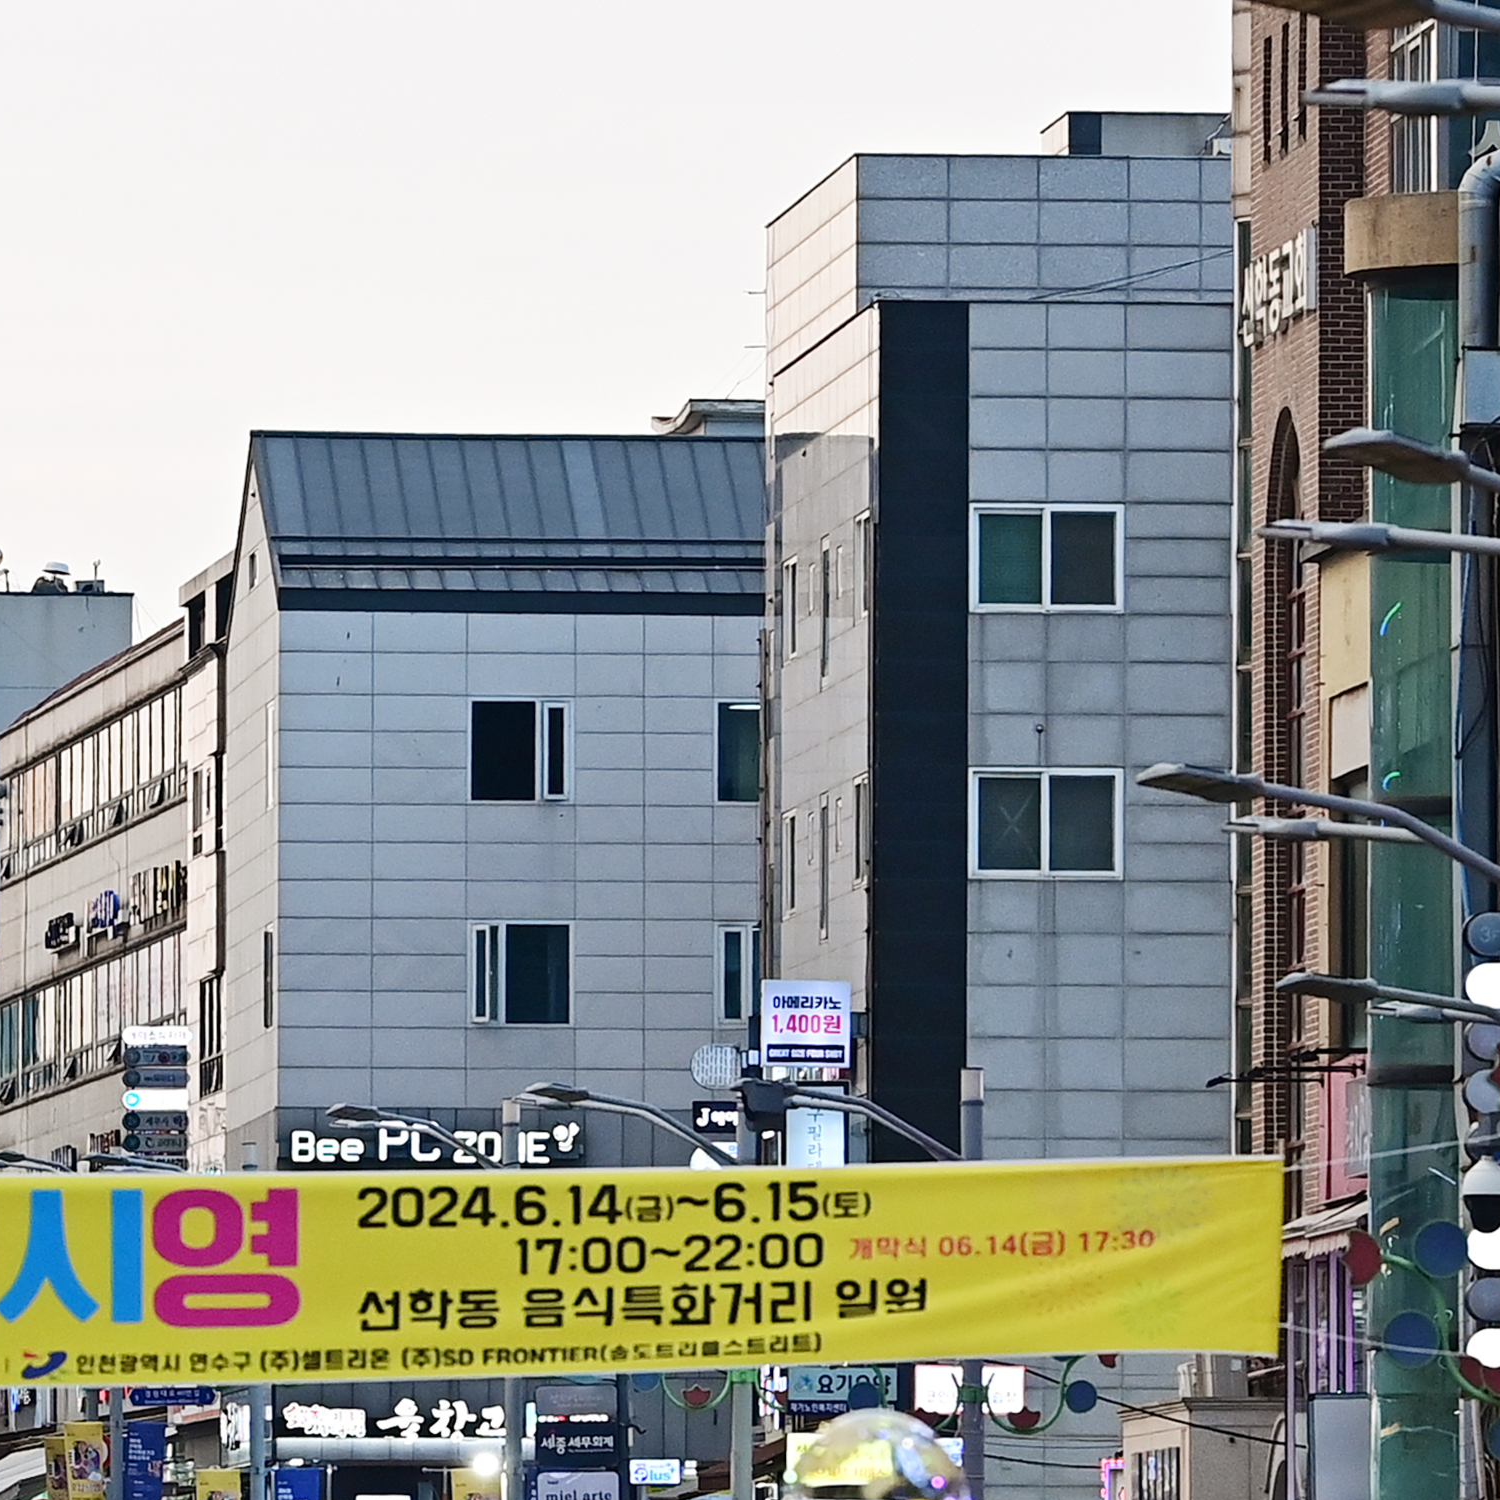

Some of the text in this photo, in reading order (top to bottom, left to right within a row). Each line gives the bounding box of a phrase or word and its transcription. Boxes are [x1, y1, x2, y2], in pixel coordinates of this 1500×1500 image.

[773, 995, 842, 1010] 아메리카노
[772, 1014, 842, 1034] 1,400원
[291, 1130, 365, 1163] Bee
[378, 1120, 441, 1162] PC
[517, 1233, 824, 1275] 17:00~22:00
[849, 1229, 1156, 1260] 개막식 06.14(금) 17:30
[358, 1277, 928, 1332] 선학동 음식특화거리 일원
[76, 1353, 181, 1375] 인천광역시
[189, 1352, 251, 1373] 연수구
[260, 1348, 390, 1374] (주)셀트리온
[402, 1345, 474, 1369] (주)SD
[540, 1433, 615, 1455] 세종 세무회계
